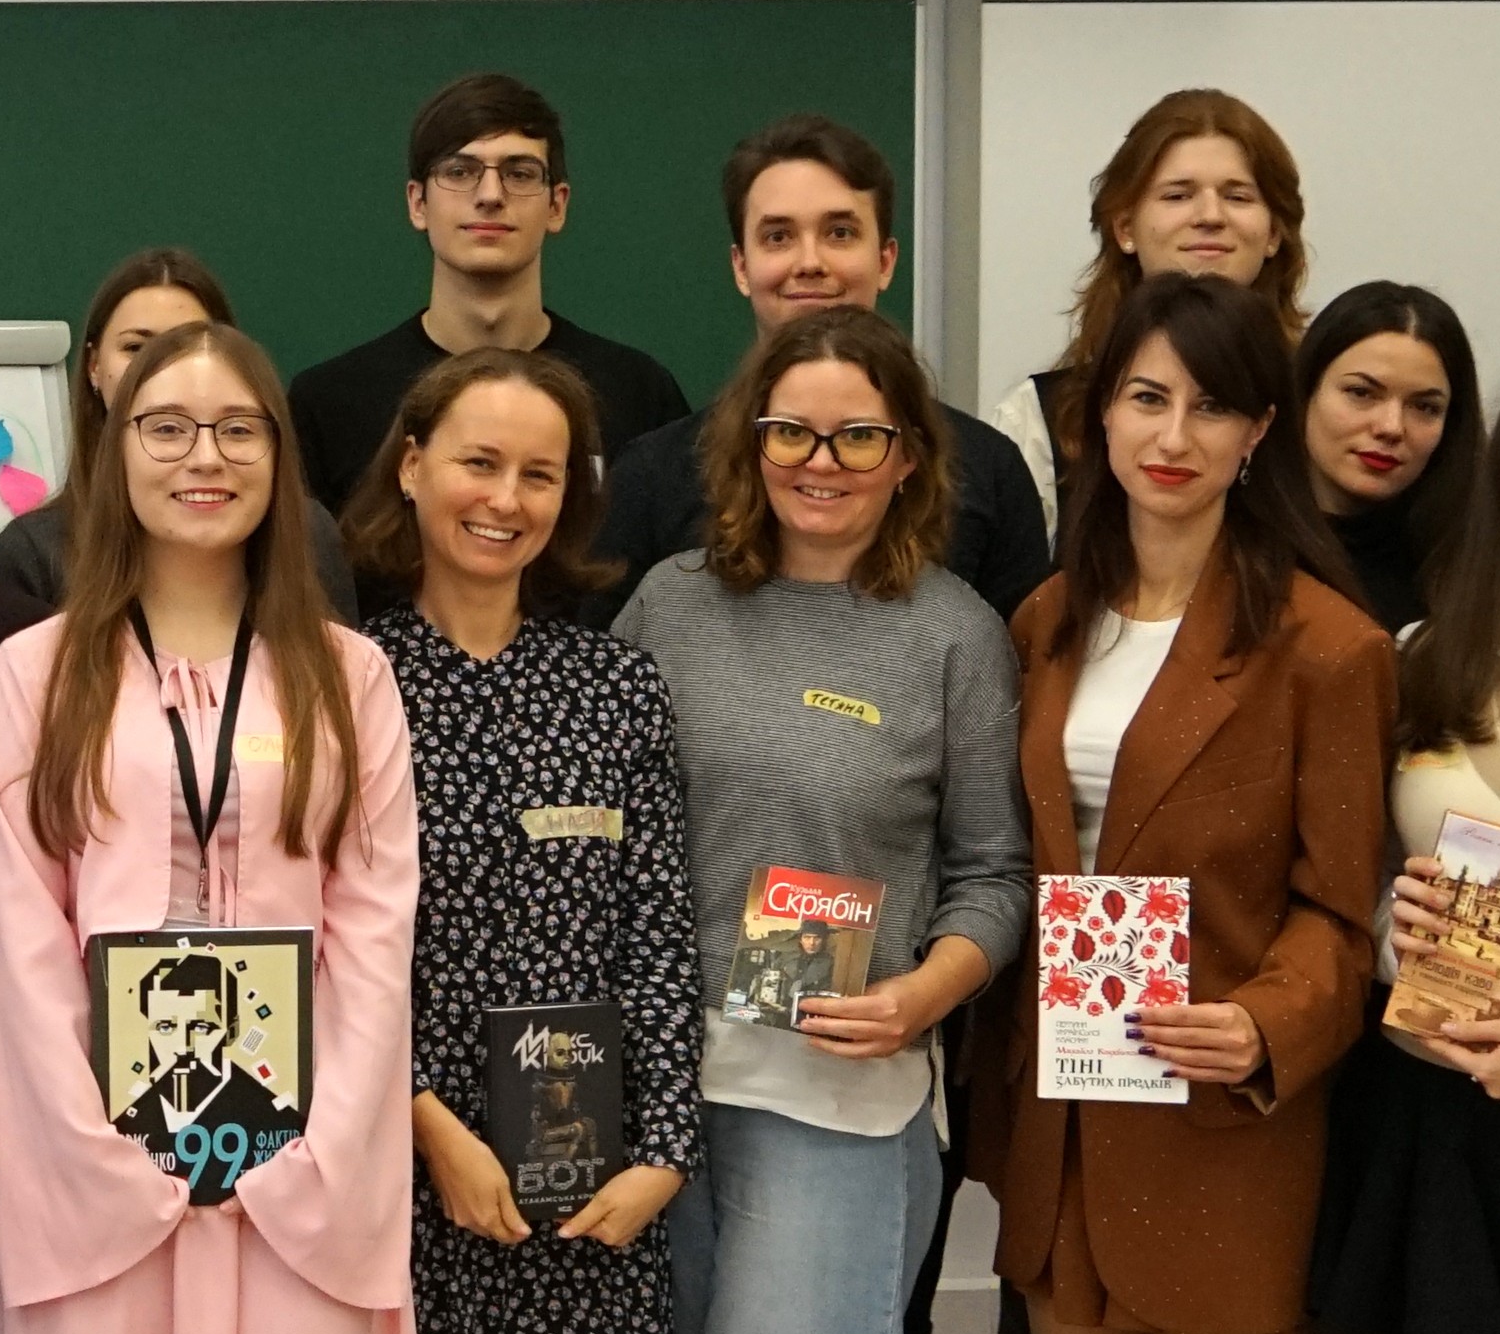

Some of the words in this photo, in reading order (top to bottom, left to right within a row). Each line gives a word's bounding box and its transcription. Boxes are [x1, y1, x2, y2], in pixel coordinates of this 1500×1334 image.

[768, 882, 872, 924] Скрябін
[1056, 1058, 1103, 1074] ТІНІ
[1056, 1076, 1114, 1090] ЗАБУТИХ
[1118, 1077, 1172, 1089] ПРЕДКІВ
[175, 1123, 248, 1189] 99
[517, 1157, 605, 1194] БОТ
